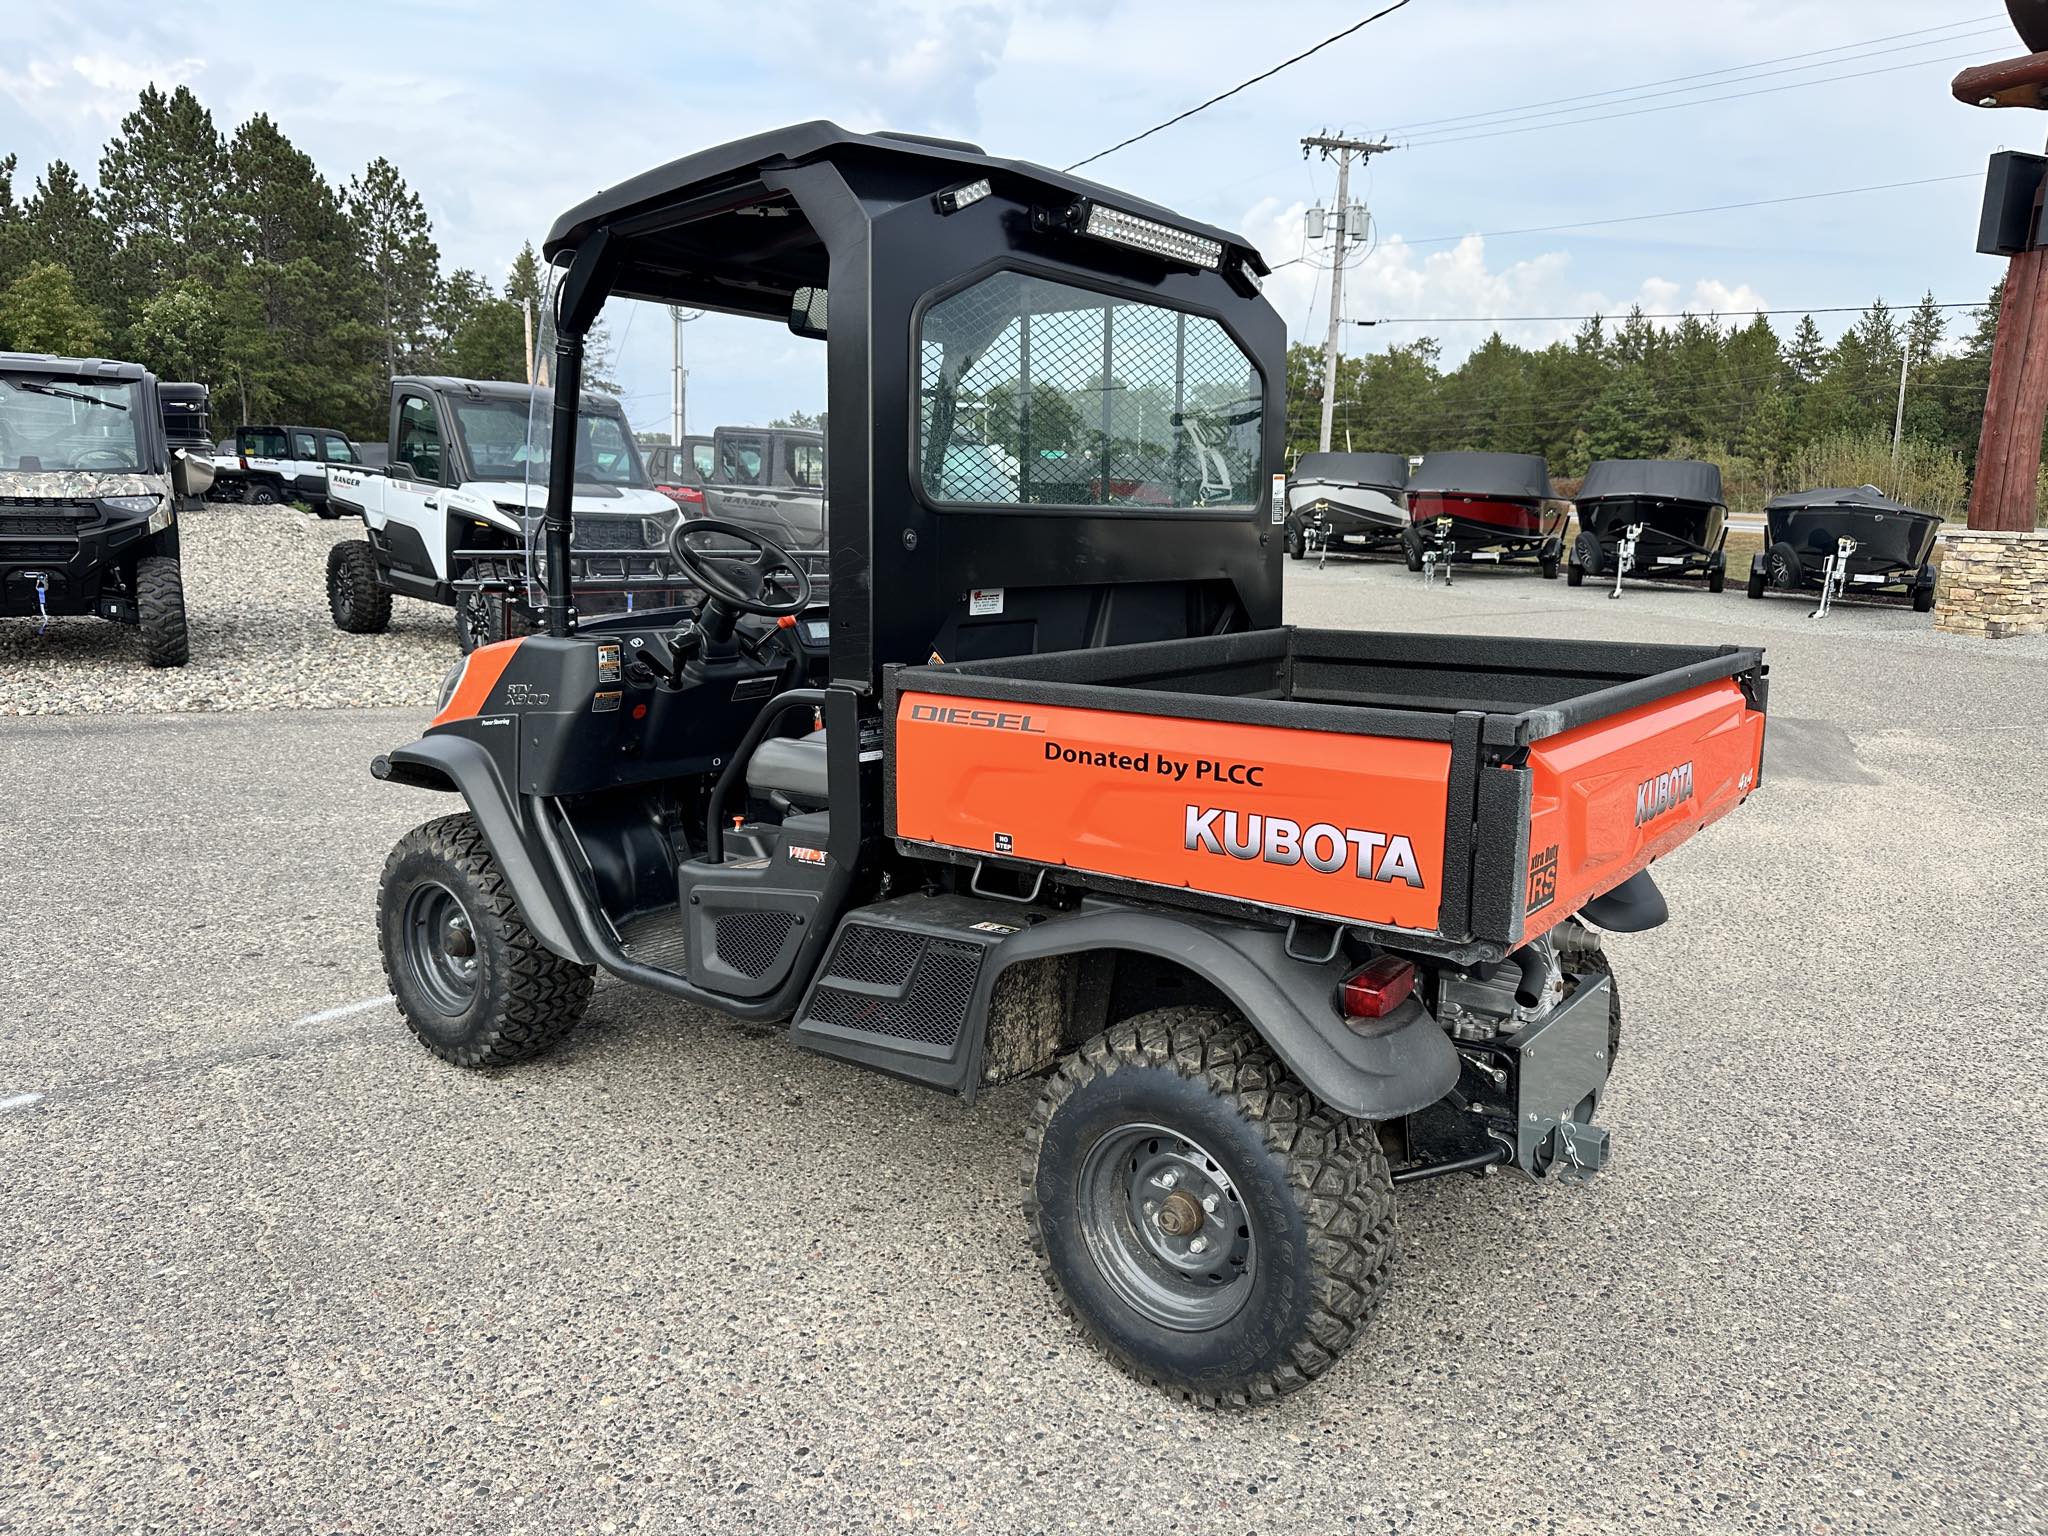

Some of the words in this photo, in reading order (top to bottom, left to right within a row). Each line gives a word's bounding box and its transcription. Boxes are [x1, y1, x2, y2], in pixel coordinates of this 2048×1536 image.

[333, 475, 361, 487] RANGER
[722, 496, 779, 509] RANGER
[507, 684, 533, 693] RTV
[505, 693, 550, 705] X900
[911, 704, 1045, 733] DIESEL
[1045, 741, 1149, 773] Donated
[1156, 754, 1188, 781] by
[1196, 760, 1264, 787] PLCC
[1634, 760, 1693, 827] KUBOTA
[996, 842, 1011, 850] STEP
[1184, 804, 1425, 889] KUBOTA
[789, 846, 828, 862] VHT-X
